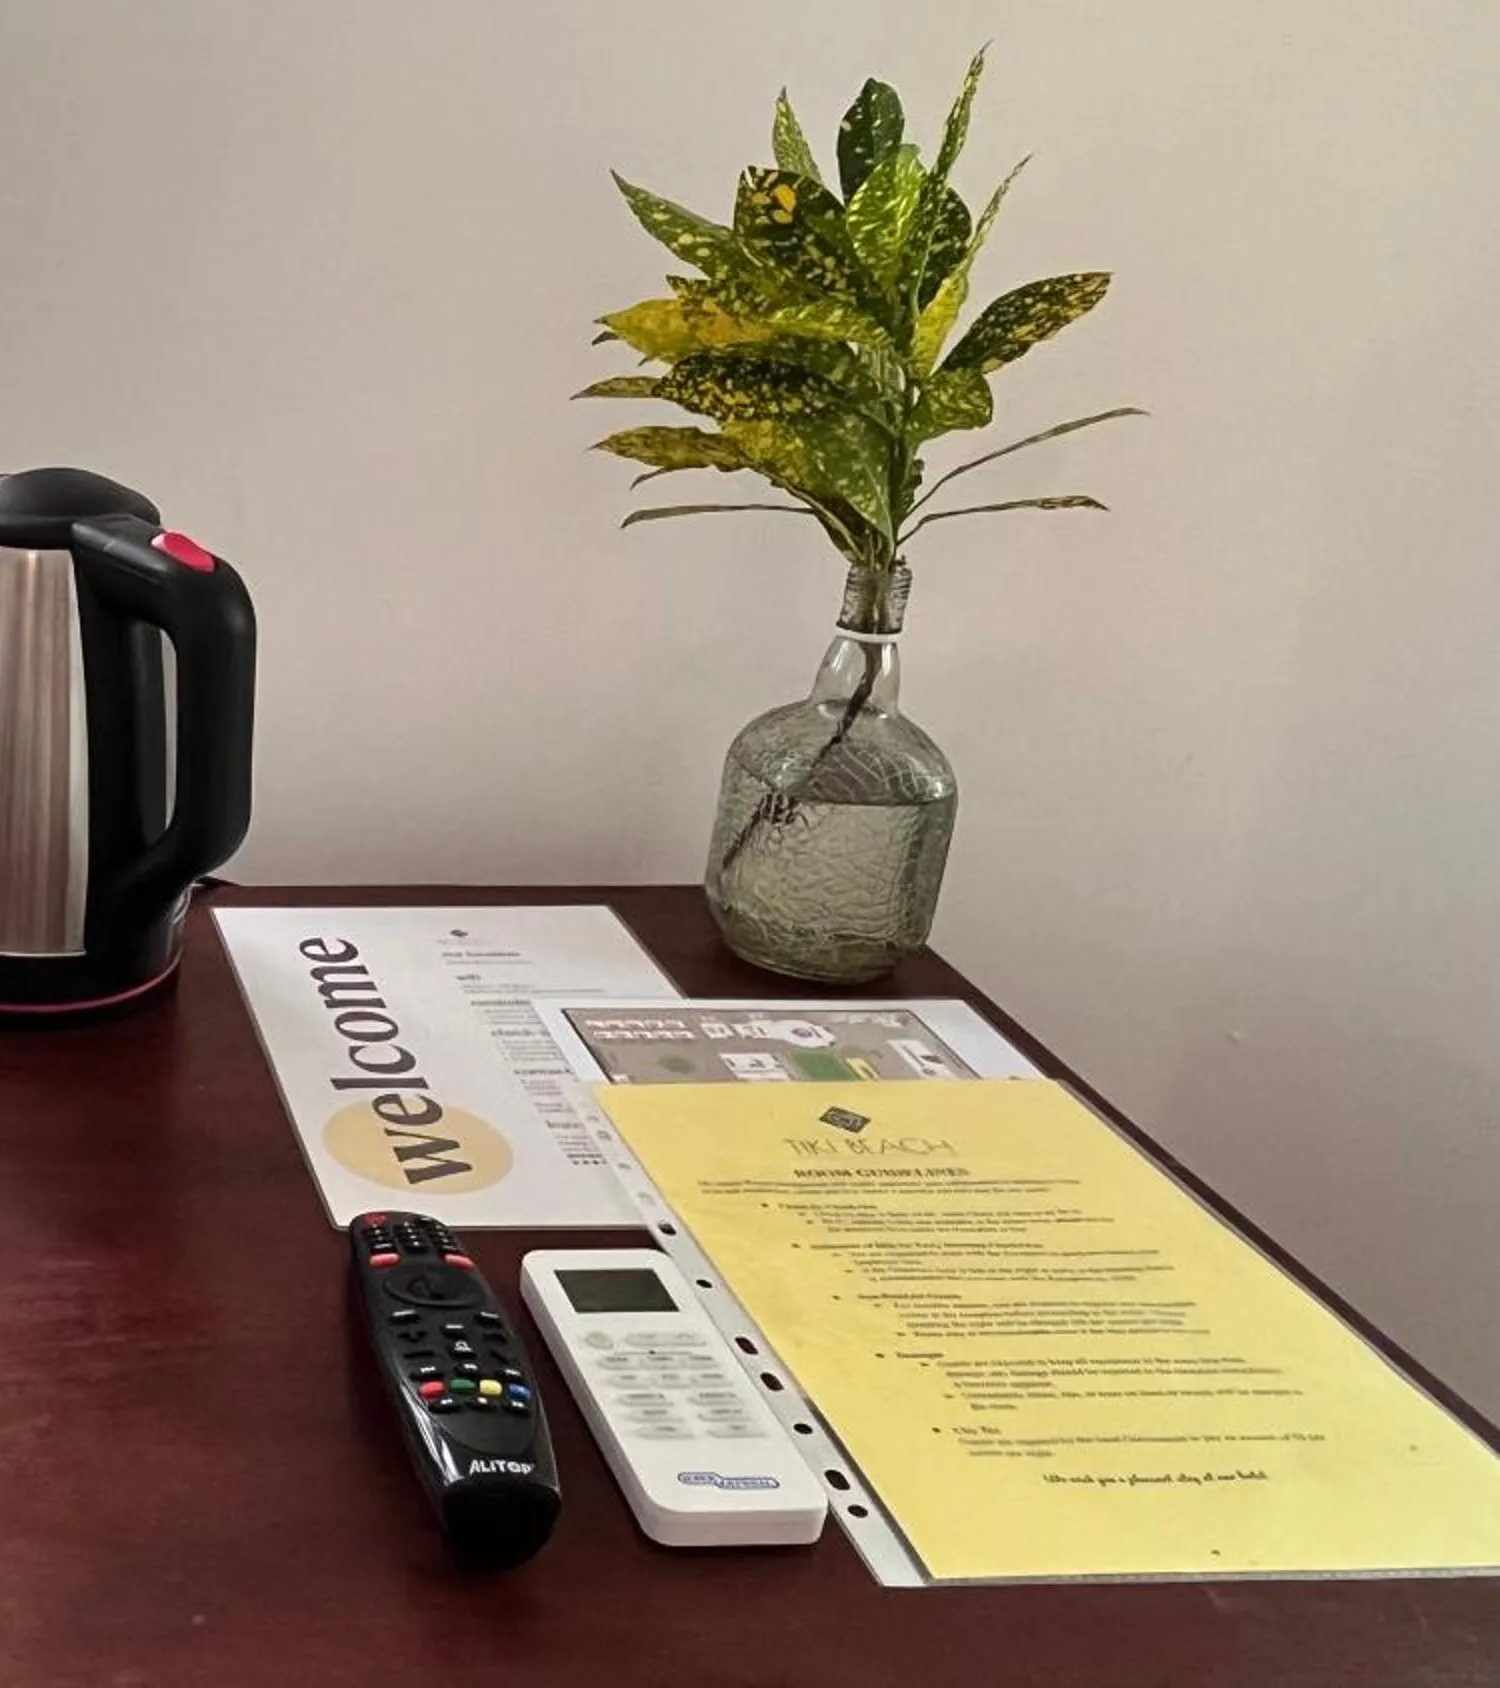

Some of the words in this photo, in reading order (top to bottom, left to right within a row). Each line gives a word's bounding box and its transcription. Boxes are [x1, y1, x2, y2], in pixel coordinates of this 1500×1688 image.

[299, 937, 474, 1185] welcome
[784, 1138, 838, 1156] TIKI
[844, 1136, 958, 1156] BEACH
[468, 1459, 536, 1476] ALITOP
